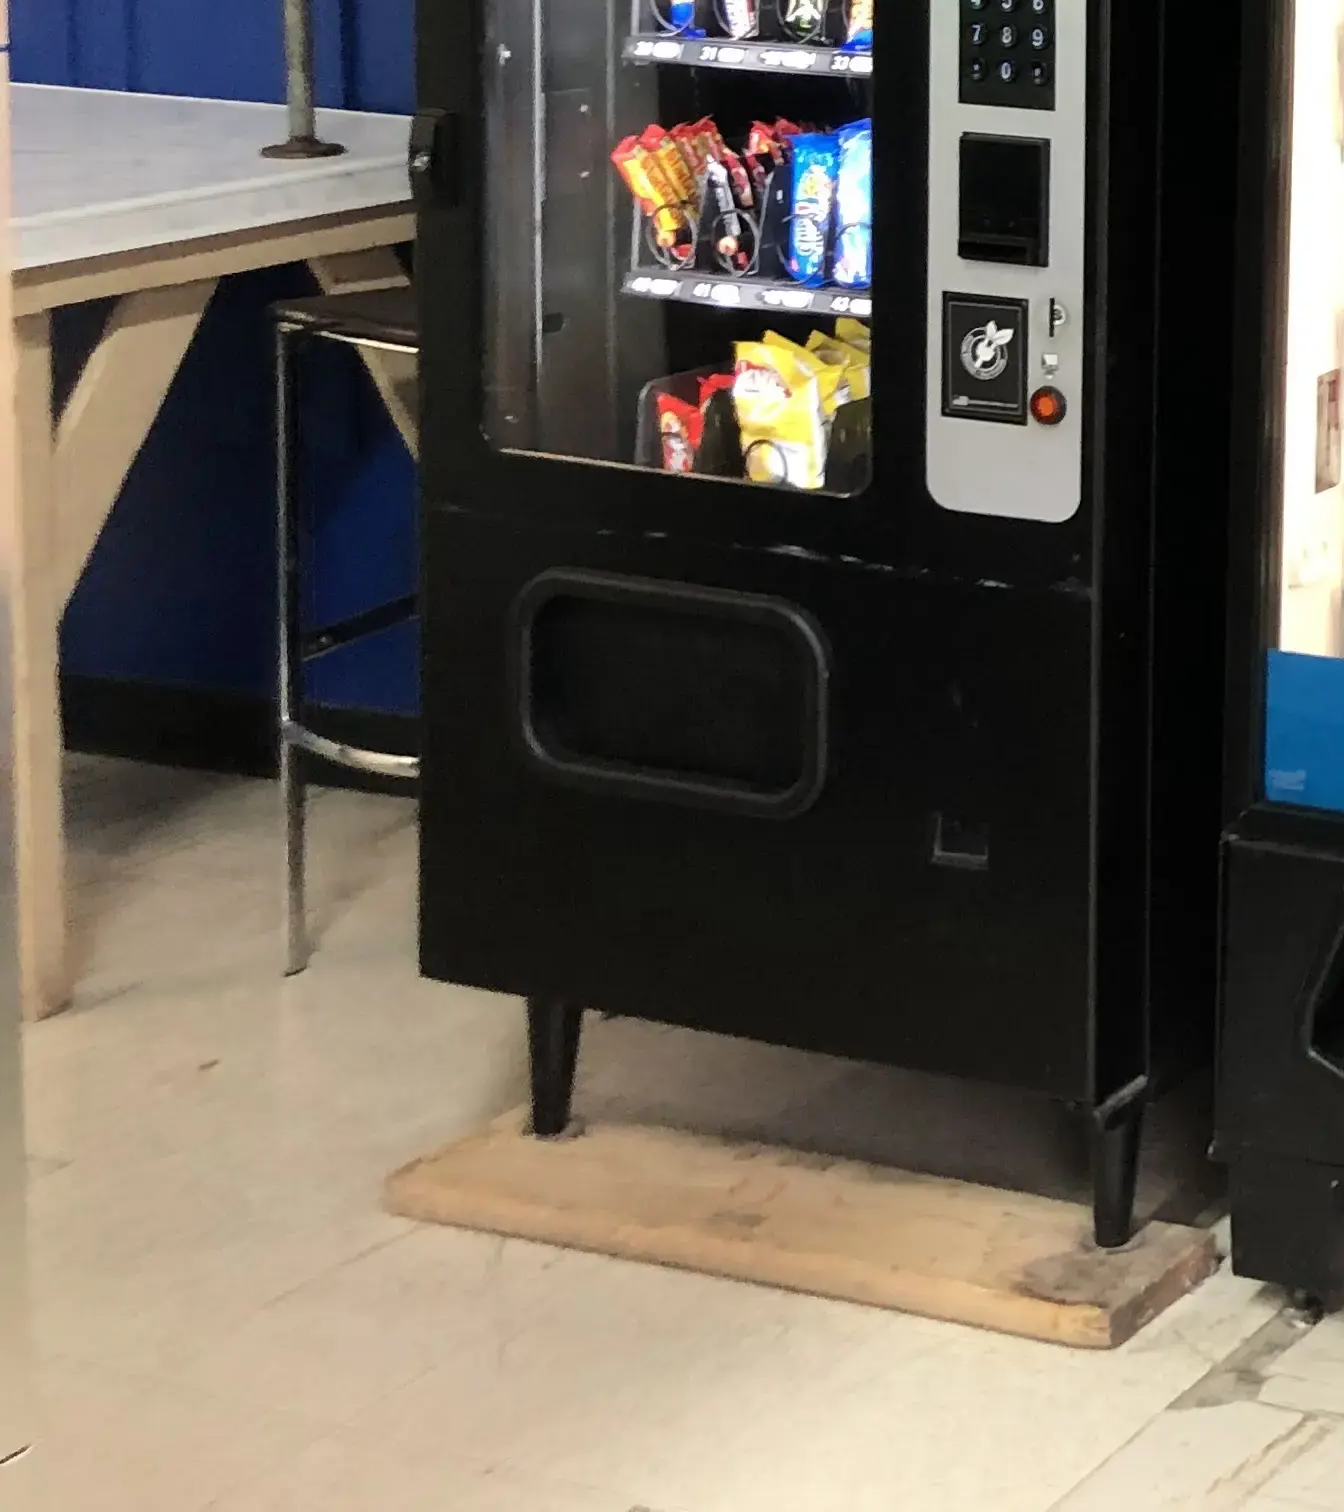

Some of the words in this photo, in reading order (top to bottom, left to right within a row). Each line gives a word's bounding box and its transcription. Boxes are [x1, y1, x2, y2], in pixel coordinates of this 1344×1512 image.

[972, 25, 982, 42] 7
[1002, 27, 1012, 44] 8
[1032, 29, 1043, 47] 9
[1001, 62, 1011, 80] 0
